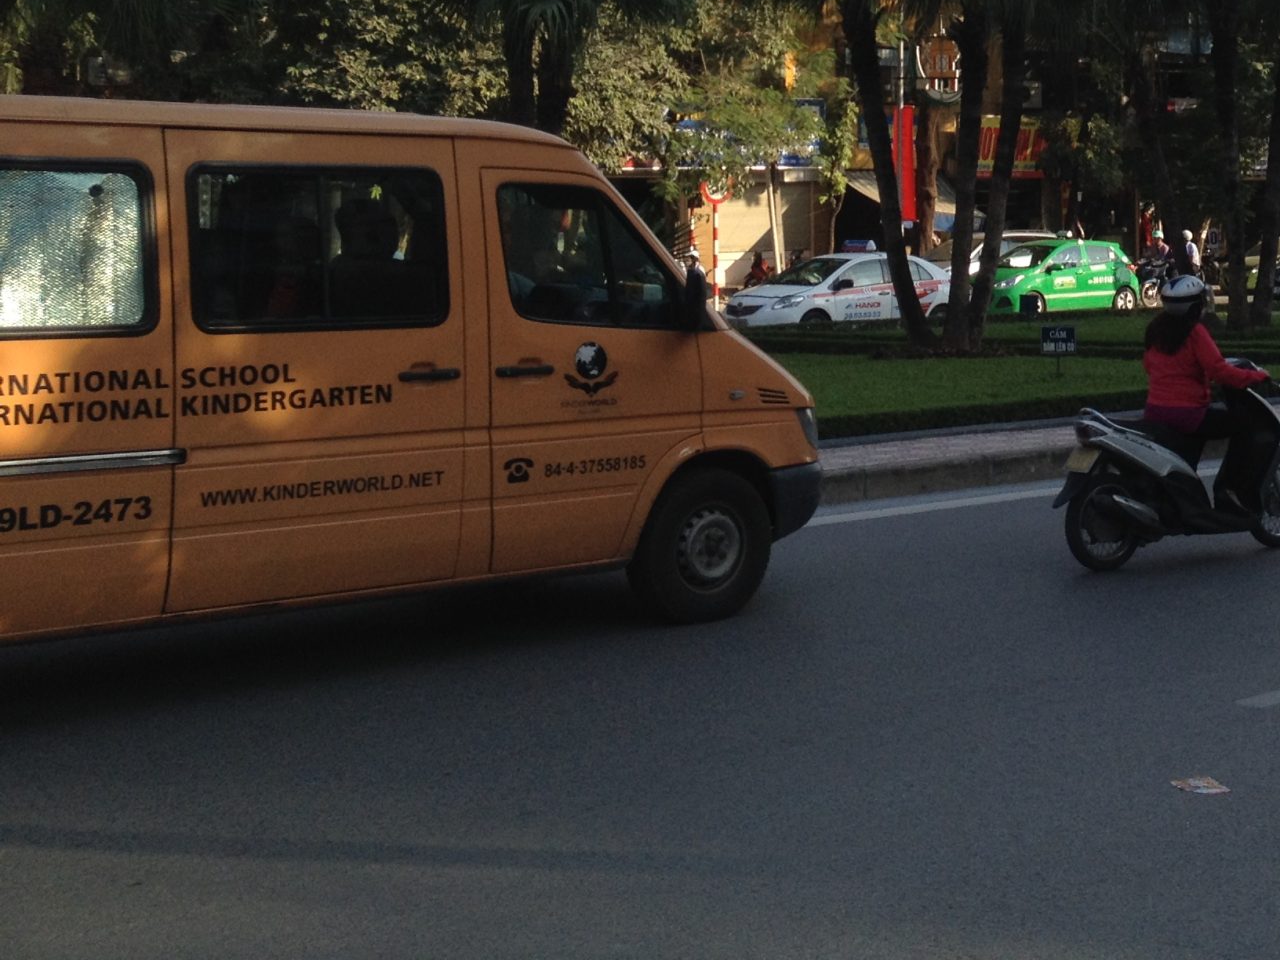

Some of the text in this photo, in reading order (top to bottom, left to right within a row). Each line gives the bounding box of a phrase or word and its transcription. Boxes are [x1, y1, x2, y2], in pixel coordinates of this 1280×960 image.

[180, 363, 296, 389] SCHOOL
[181, 383, 393, 417] KINDERGARTEN
[544, 455, 647, 478] 84-4-37558185
[201, 470, 445, 507] WWW.KINDERWORLD.NET
